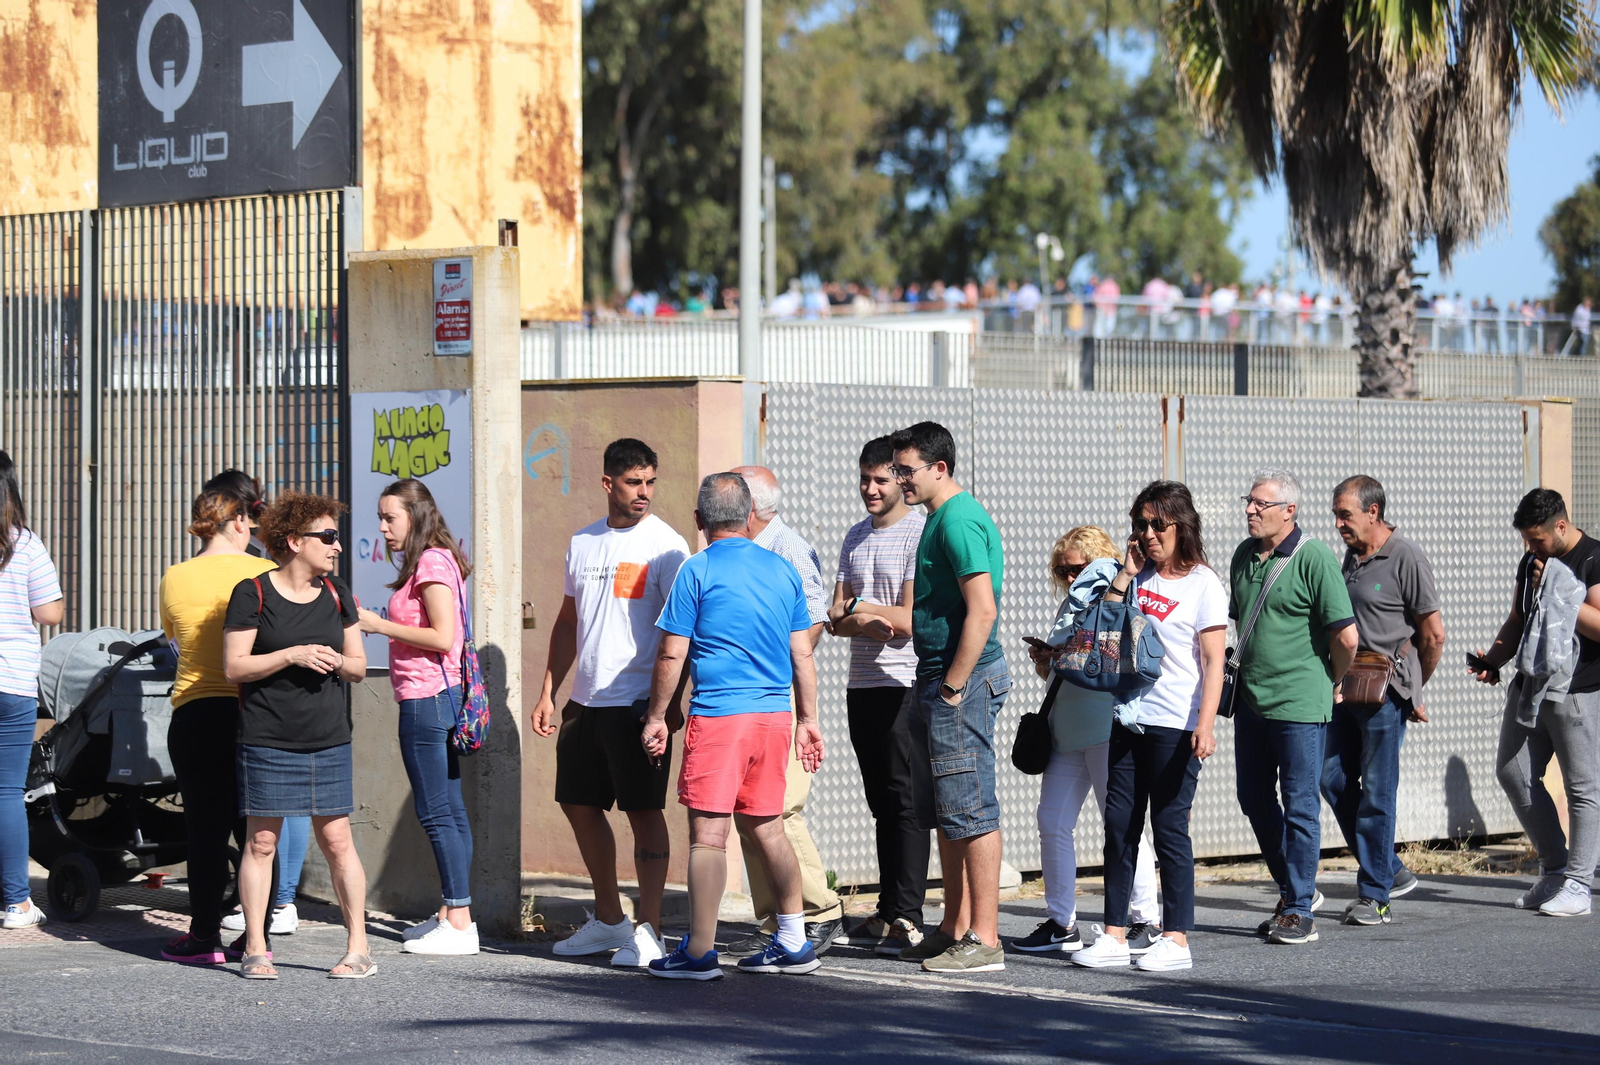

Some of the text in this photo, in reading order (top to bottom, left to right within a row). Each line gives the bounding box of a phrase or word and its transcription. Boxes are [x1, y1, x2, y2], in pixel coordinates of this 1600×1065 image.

[114, 132, 228, 170] LIQUID
[188, 166, 208, 178] club
[440, 278, 466, 296] Direct
[437, 303, 469, 315] Alarma
[371, 429, 451, 479] MAGIC
[1138, 595, 1169, 613] evi's
